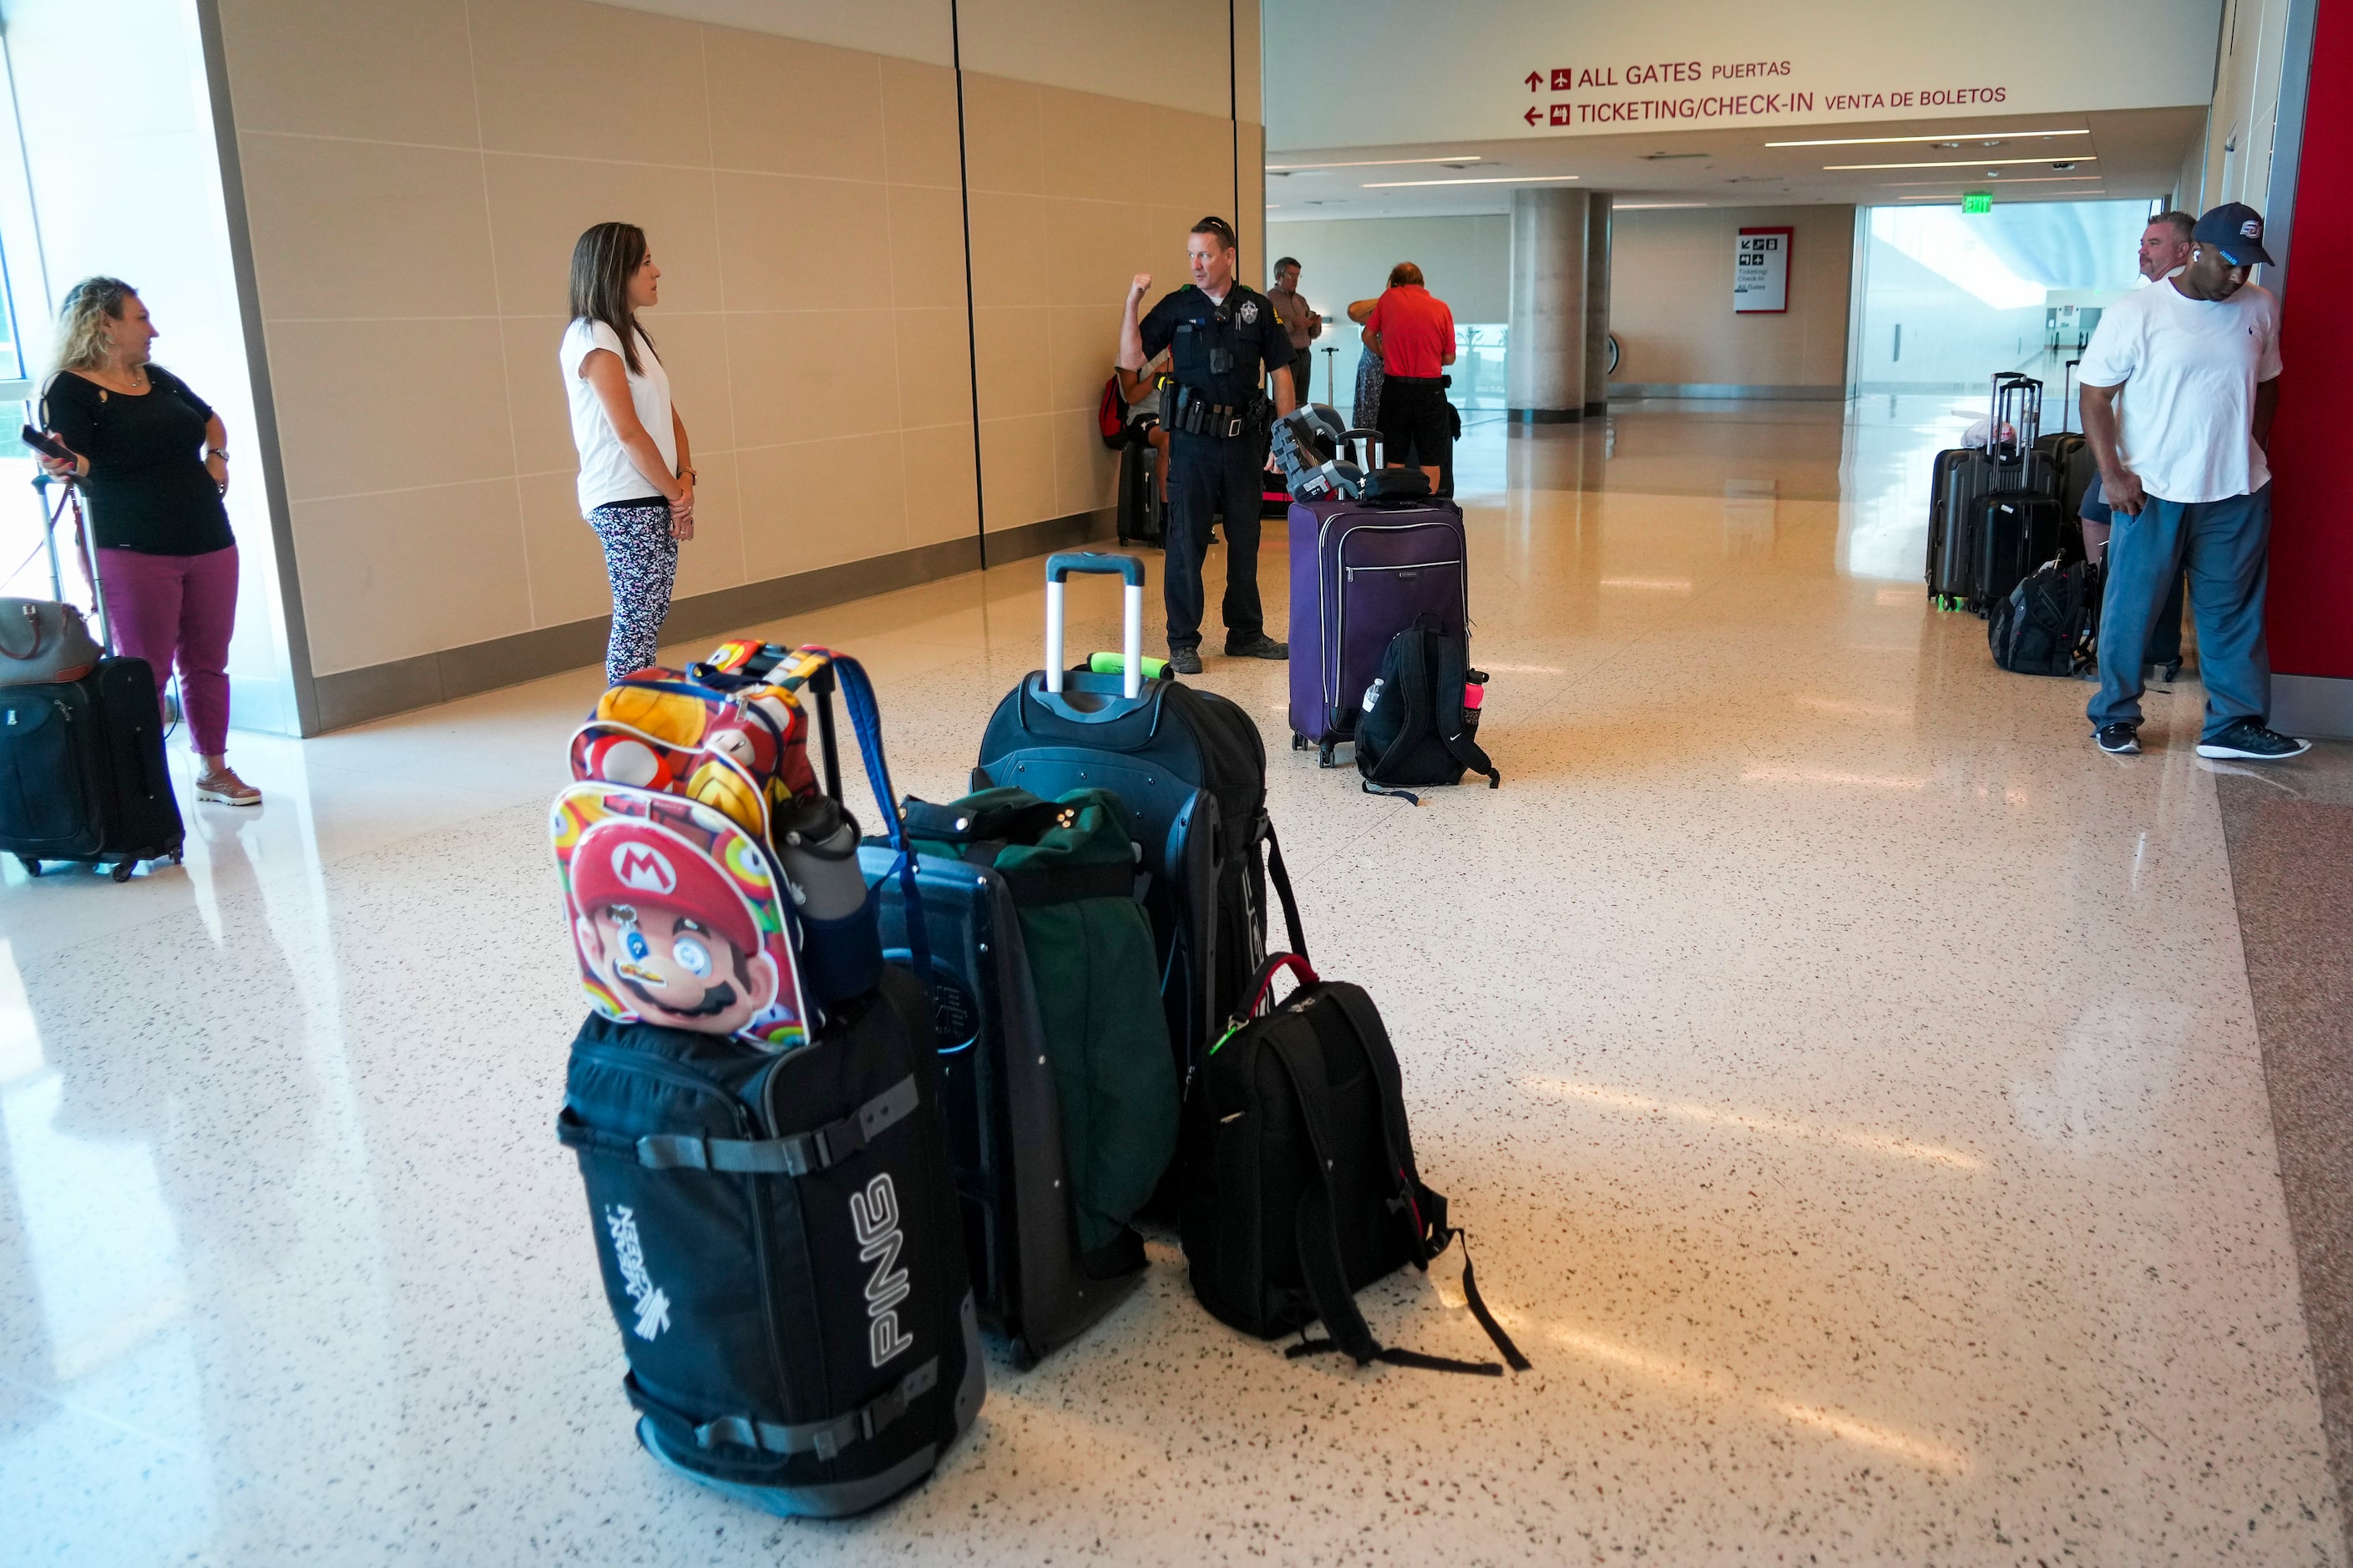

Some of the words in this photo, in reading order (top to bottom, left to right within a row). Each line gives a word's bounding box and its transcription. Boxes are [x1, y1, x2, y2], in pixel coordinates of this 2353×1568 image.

[1577, 68, 1618, 88] ALL
[1625, 61, 1703, 85] GATES
[1711, 61, 1791, 79] PUERTAS
[1576, 93, 1814, 123] TICKETING/CHECK-IN
[1824, 94, 1885, 110] VENTA
[1890, 92, 1915, 107] DE
[1919, 88, 2006, 106] BOLETOS
[1965, 197, 1991, 214] EXIT
[849, 1171, 914, 1368] PING
